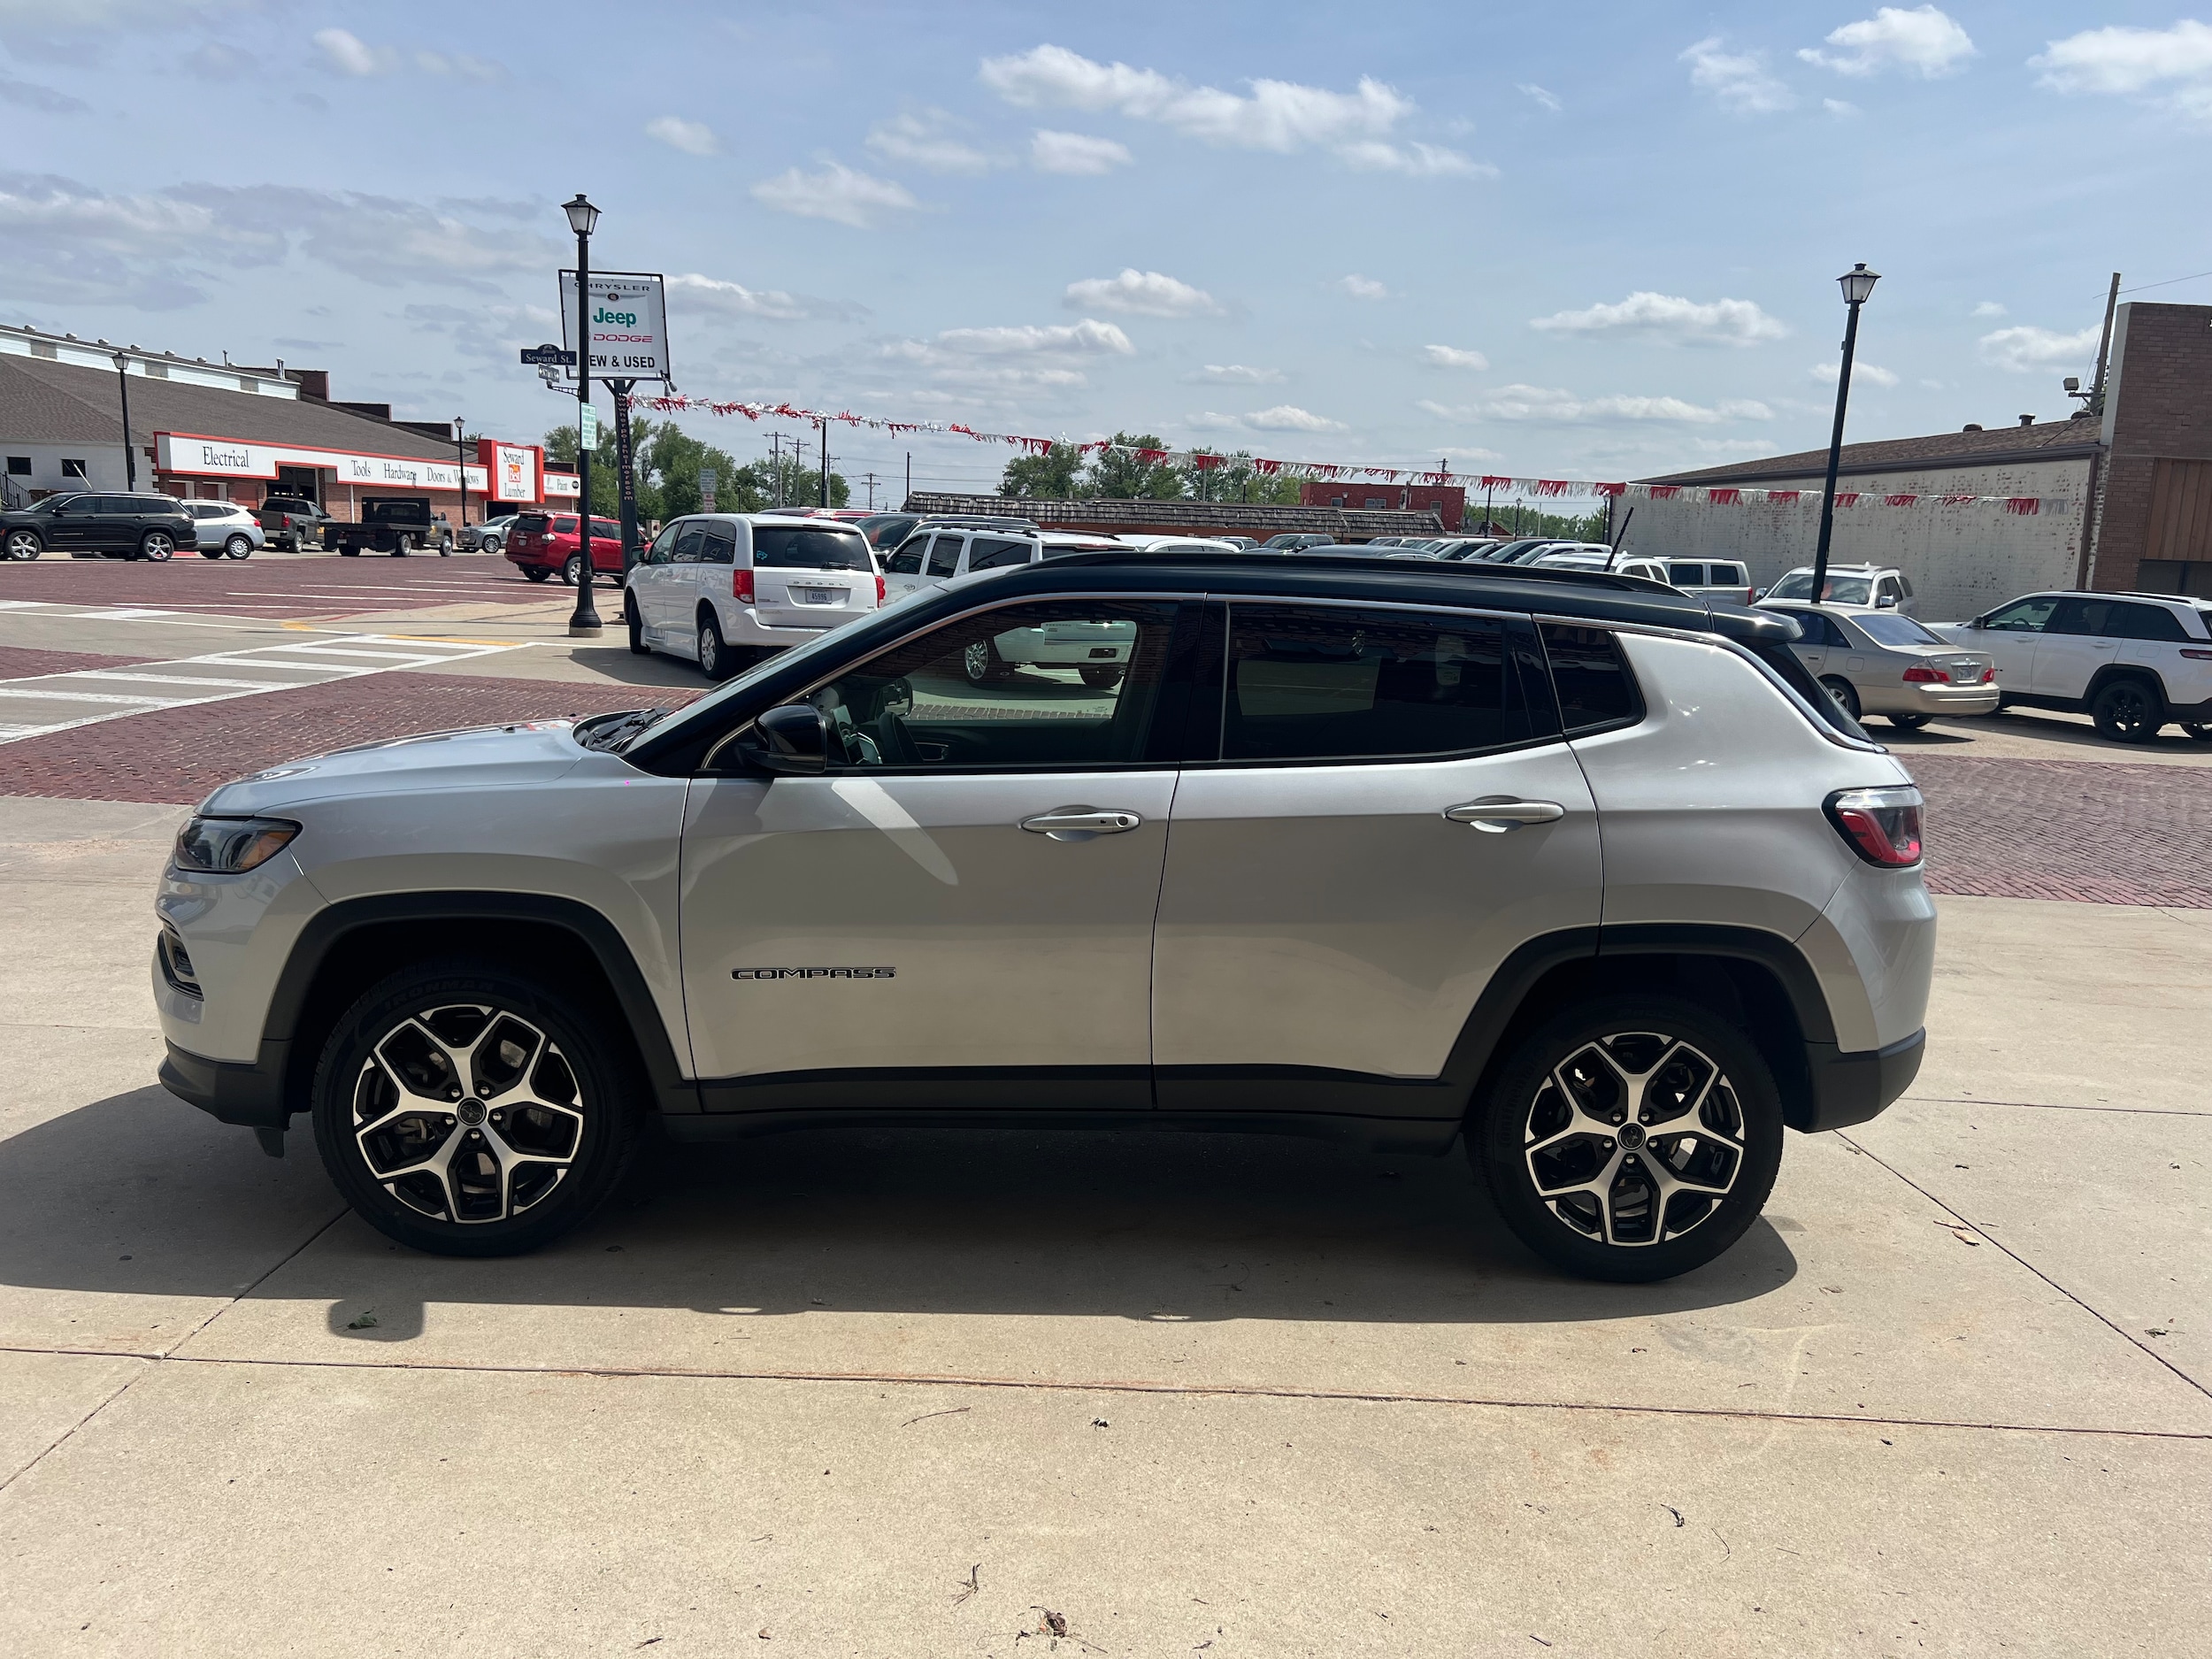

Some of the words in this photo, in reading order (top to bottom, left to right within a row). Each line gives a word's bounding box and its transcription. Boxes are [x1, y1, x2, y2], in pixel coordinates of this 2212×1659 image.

[593, 307, 636, 328] Jeep
[594, 334, 653, 342] DODGE
[526, 353, 557, 363] Seward
[560, 355, 572, 364] St.
[588, 355, 607, 366] EW
[611, 356, 620, 367] &
[623, 356, 656, 368] USED
[203, 446, 250, 468] Electrical
[503, 447, 525, 465] Seward
[351, 460, 371, 477] Tools
[426, 466, 446, 482] Doors
[453, 469, 480, 484] Wdows
[509, 467, 520, 481] Best
[504, 482, 526, 498] Lumber
[557, 479, 568, 491] Paint
[730, 966, 896, 980] COMPASS
